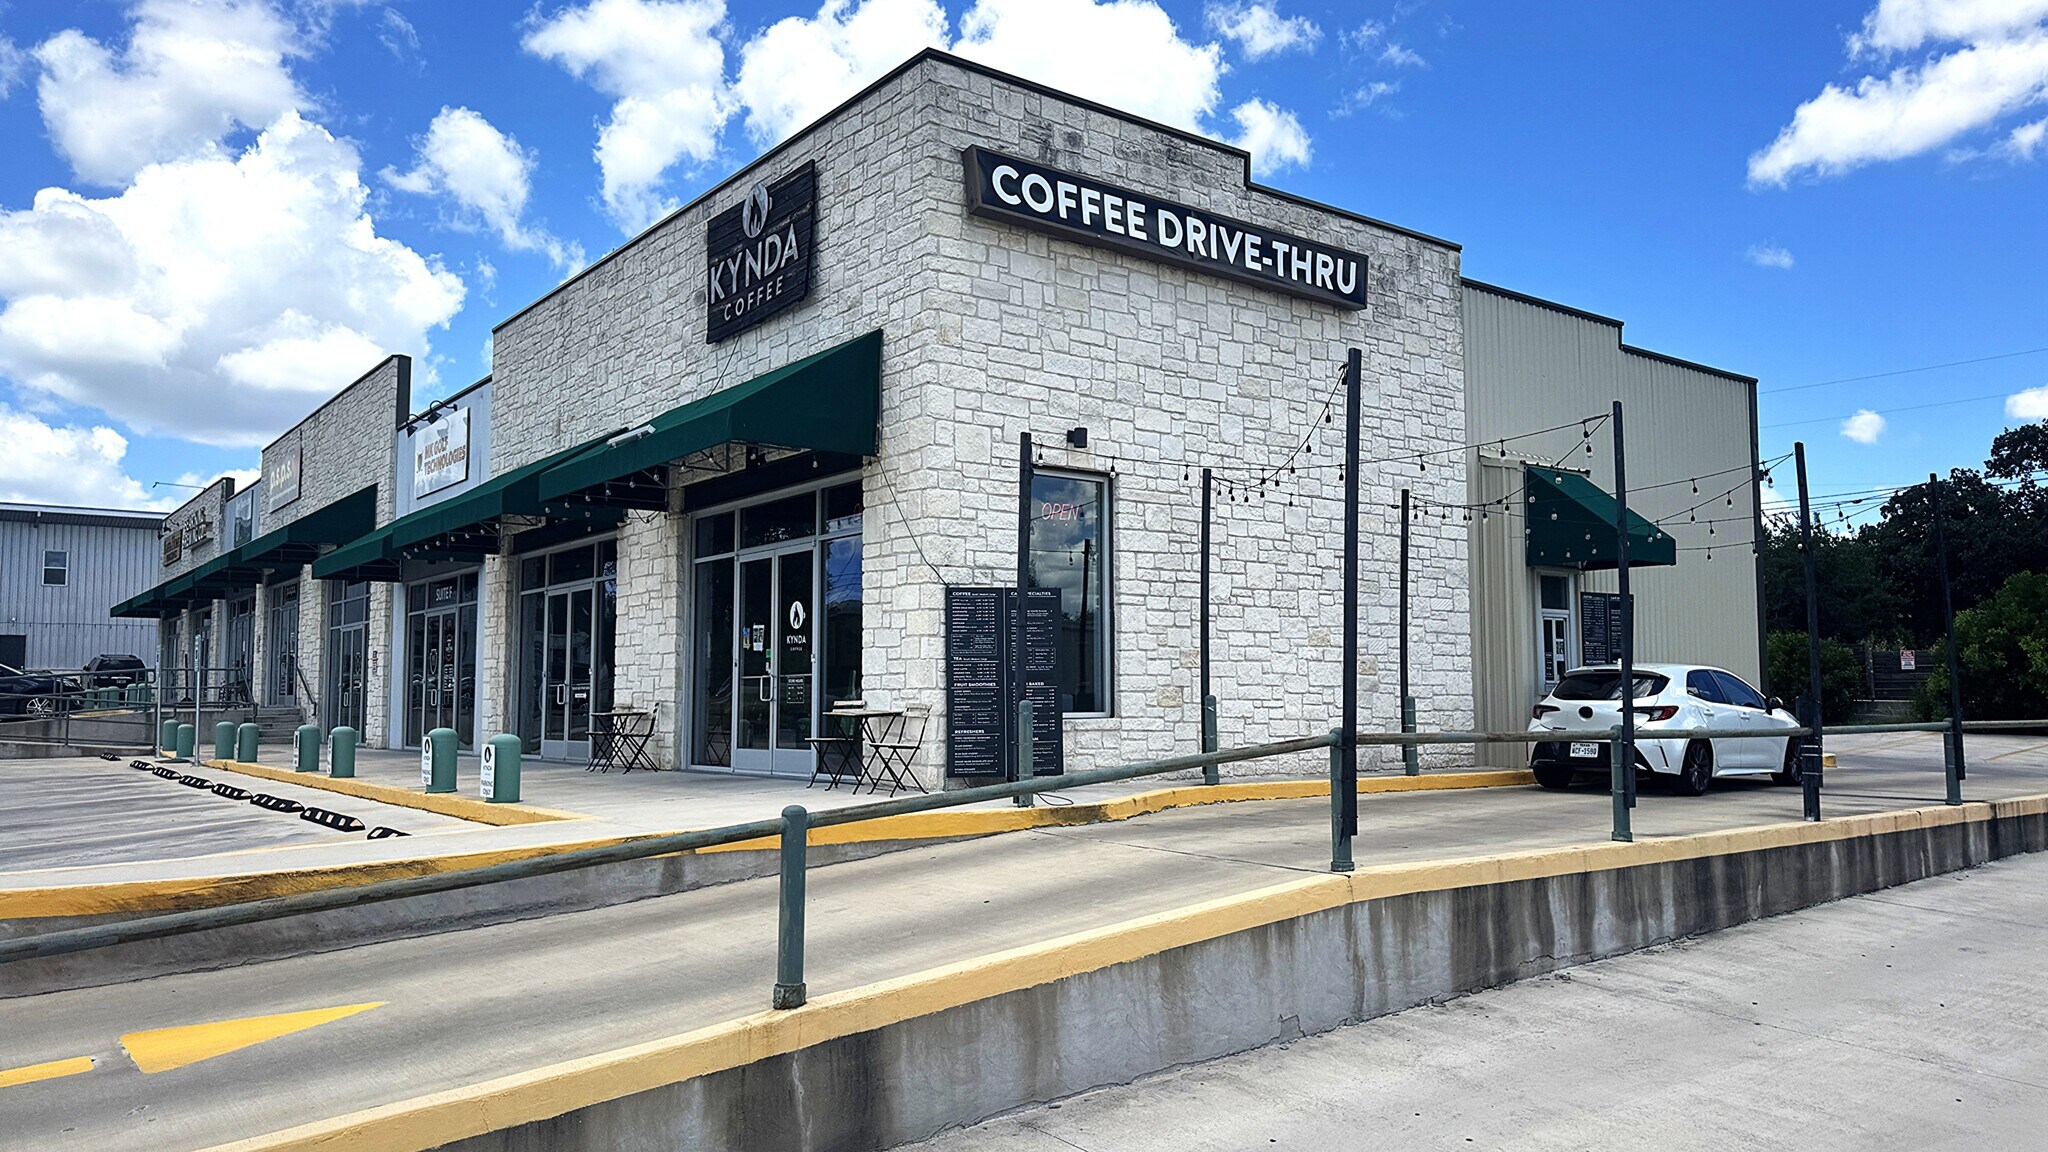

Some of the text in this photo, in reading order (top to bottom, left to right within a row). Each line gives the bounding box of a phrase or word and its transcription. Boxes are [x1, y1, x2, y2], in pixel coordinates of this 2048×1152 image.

[992, 165, 1357, 294] COFFEE DRIVE-THRU
[710, 223, 799, 304] KYNDA
[724, 275, 784, 321] COFFEE
[433, 436, 449, 455] GOLF
[424, 445, 466, 476] TECHNOLOGIES
[1041, 502, 1080, 521] OPEN
[436, 587, 449, 601] SUITE
[786, 635, 807, 645] KYNDA
